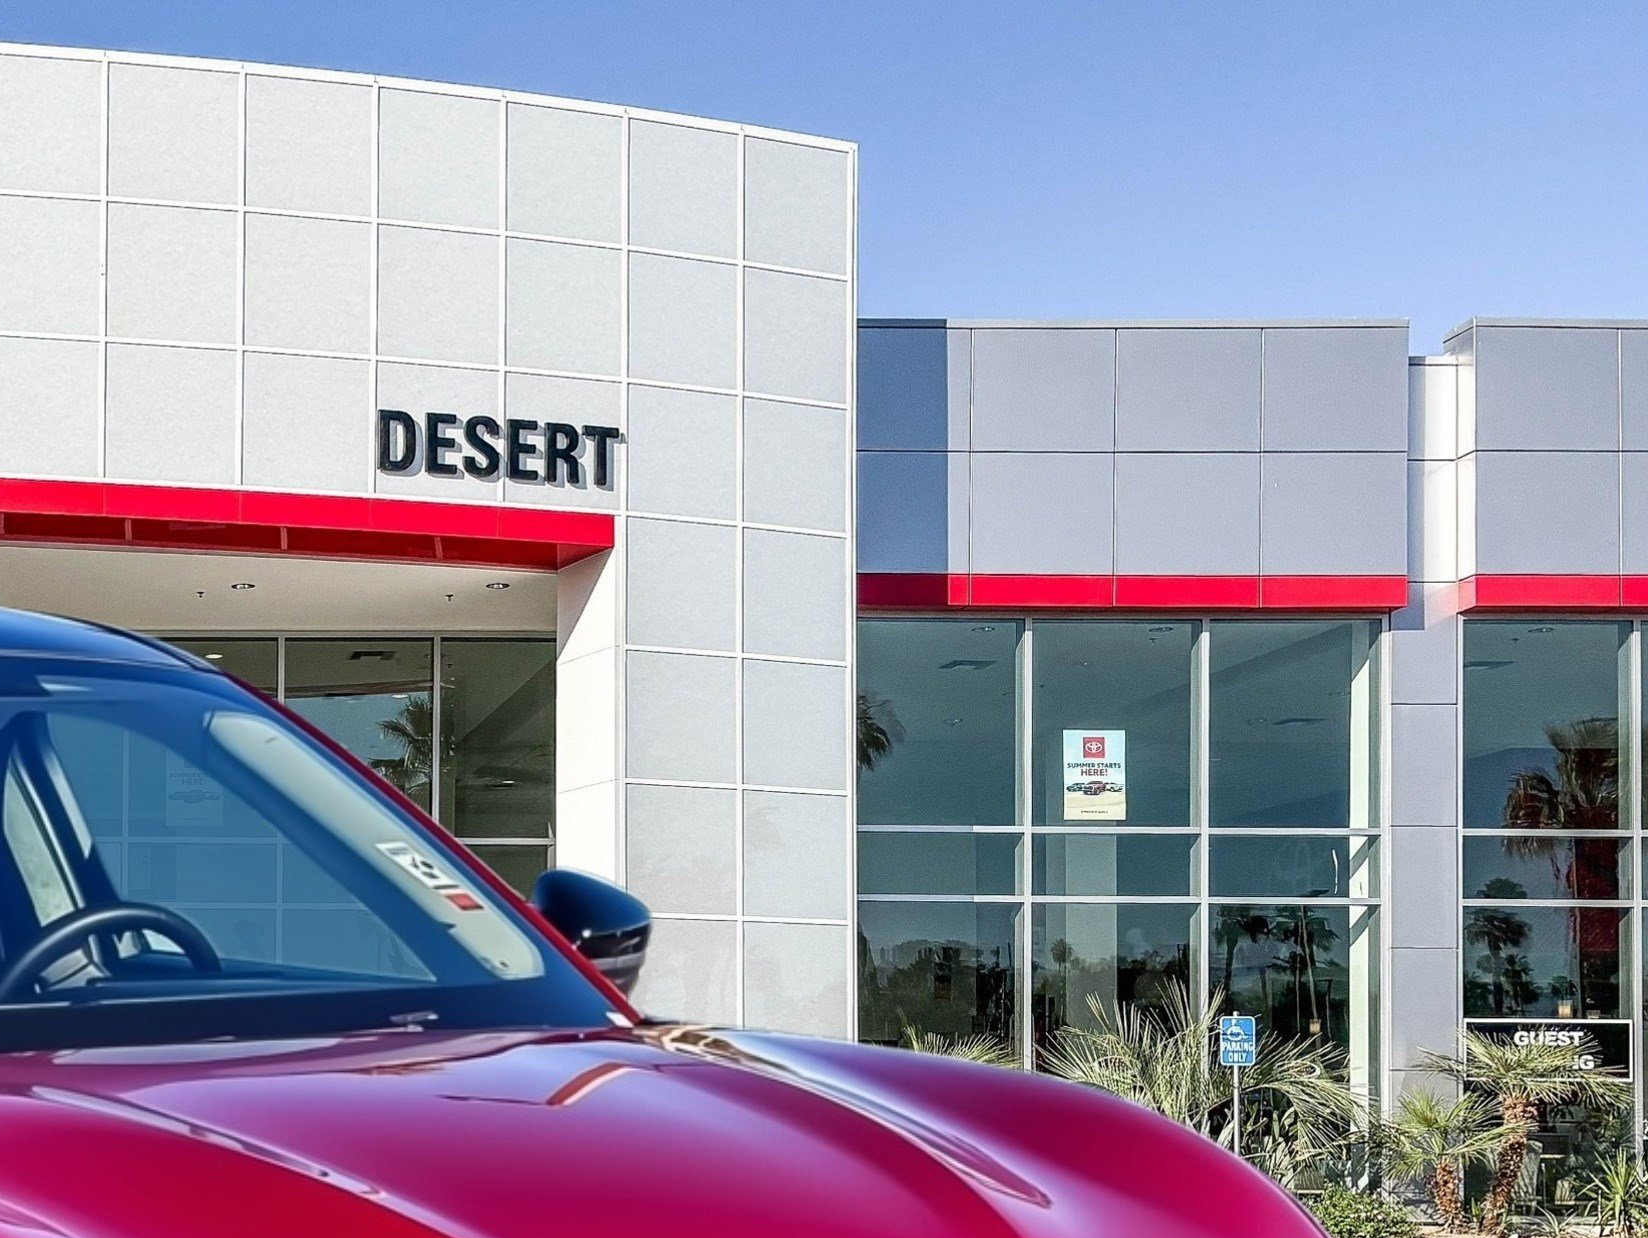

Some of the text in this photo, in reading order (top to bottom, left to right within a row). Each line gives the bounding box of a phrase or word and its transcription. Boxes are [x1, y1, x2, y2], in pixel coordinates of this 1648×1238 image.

[377, 409, 621, 487] DESERT
[1080, 769, 1108, 777] HERE!
[1513, 1031, 1584, 1047] GUEST
[1222, 1041, 1254, 1052] PARKING
[1228, 1052, 1248, 1063] ONLY
